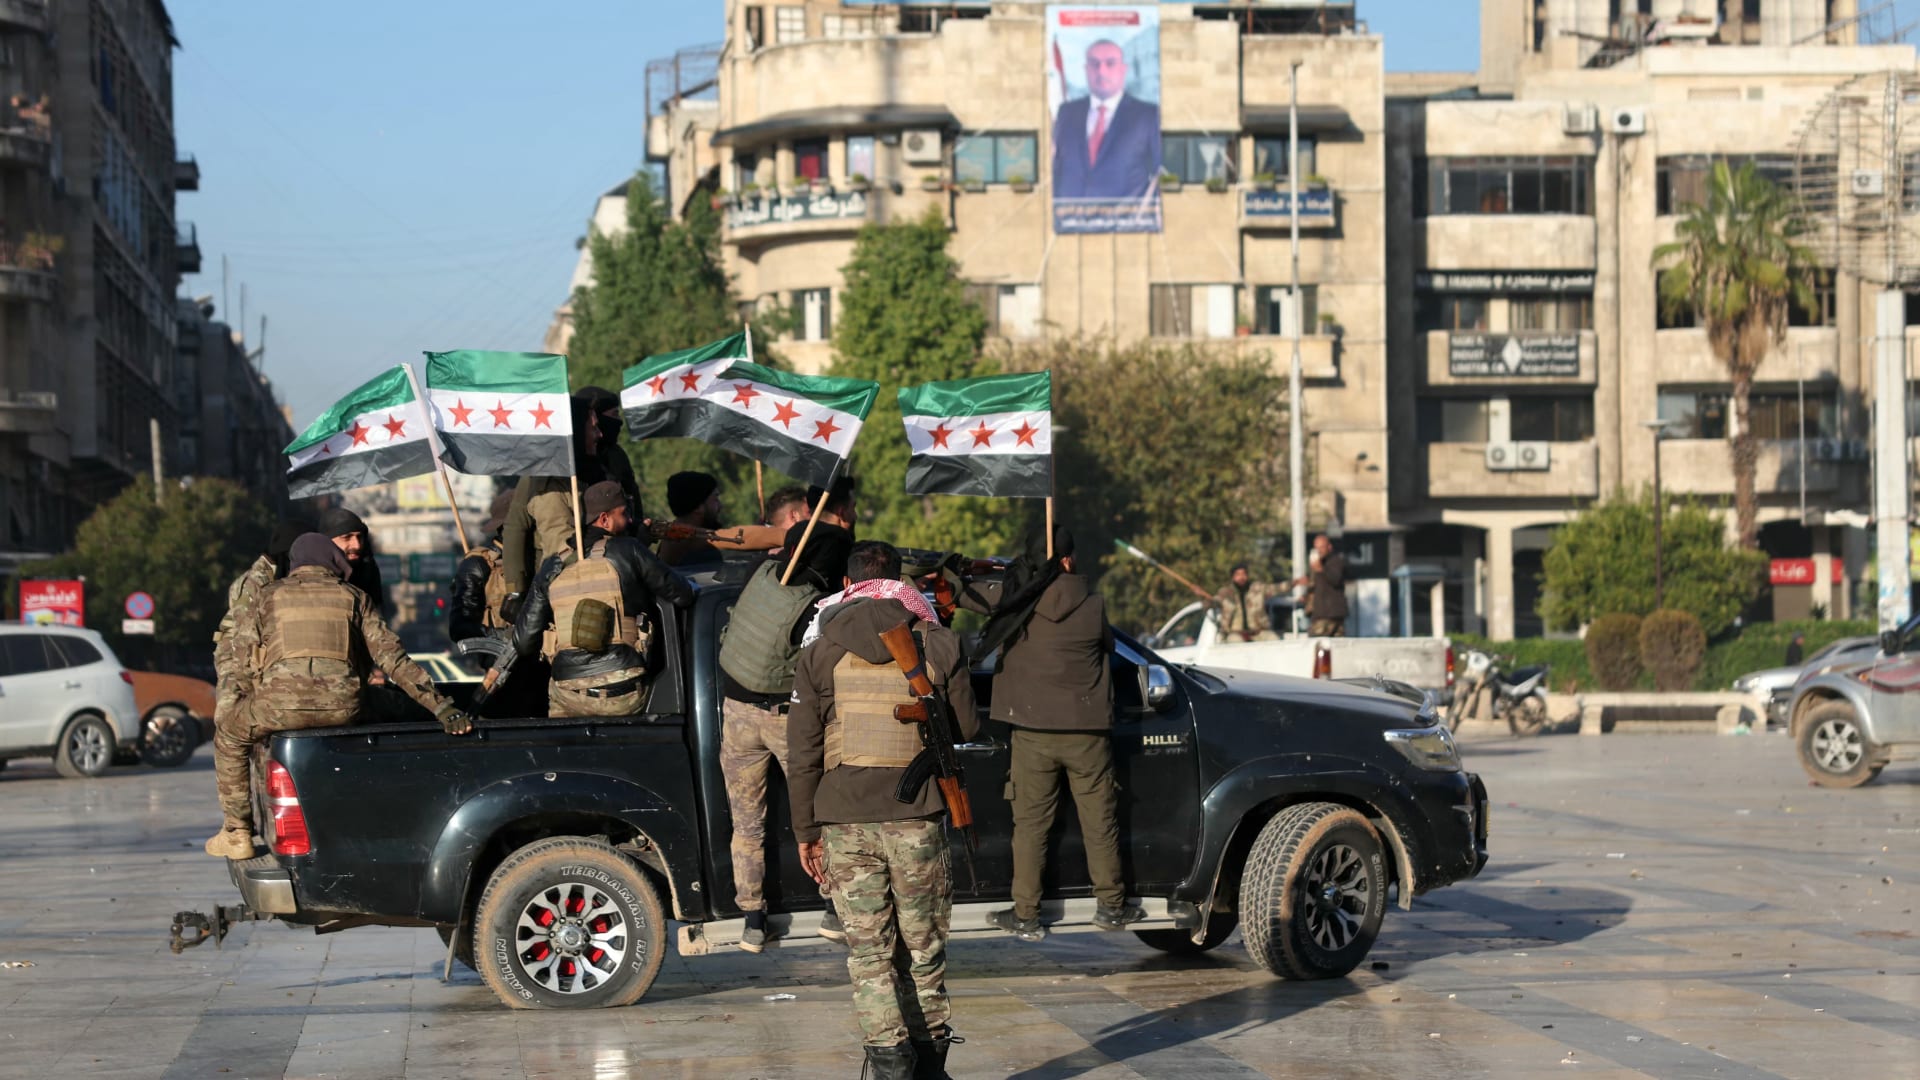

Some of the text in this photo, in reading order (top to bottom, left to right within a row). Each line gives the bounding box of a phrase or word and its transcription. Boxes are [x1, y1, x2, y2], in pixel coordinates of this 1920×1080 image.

[809, 192, 866, 217] شركة
[561, 864, 646, 928] TERRAMAX
[496, 938, 534, 1000] SAILUN
